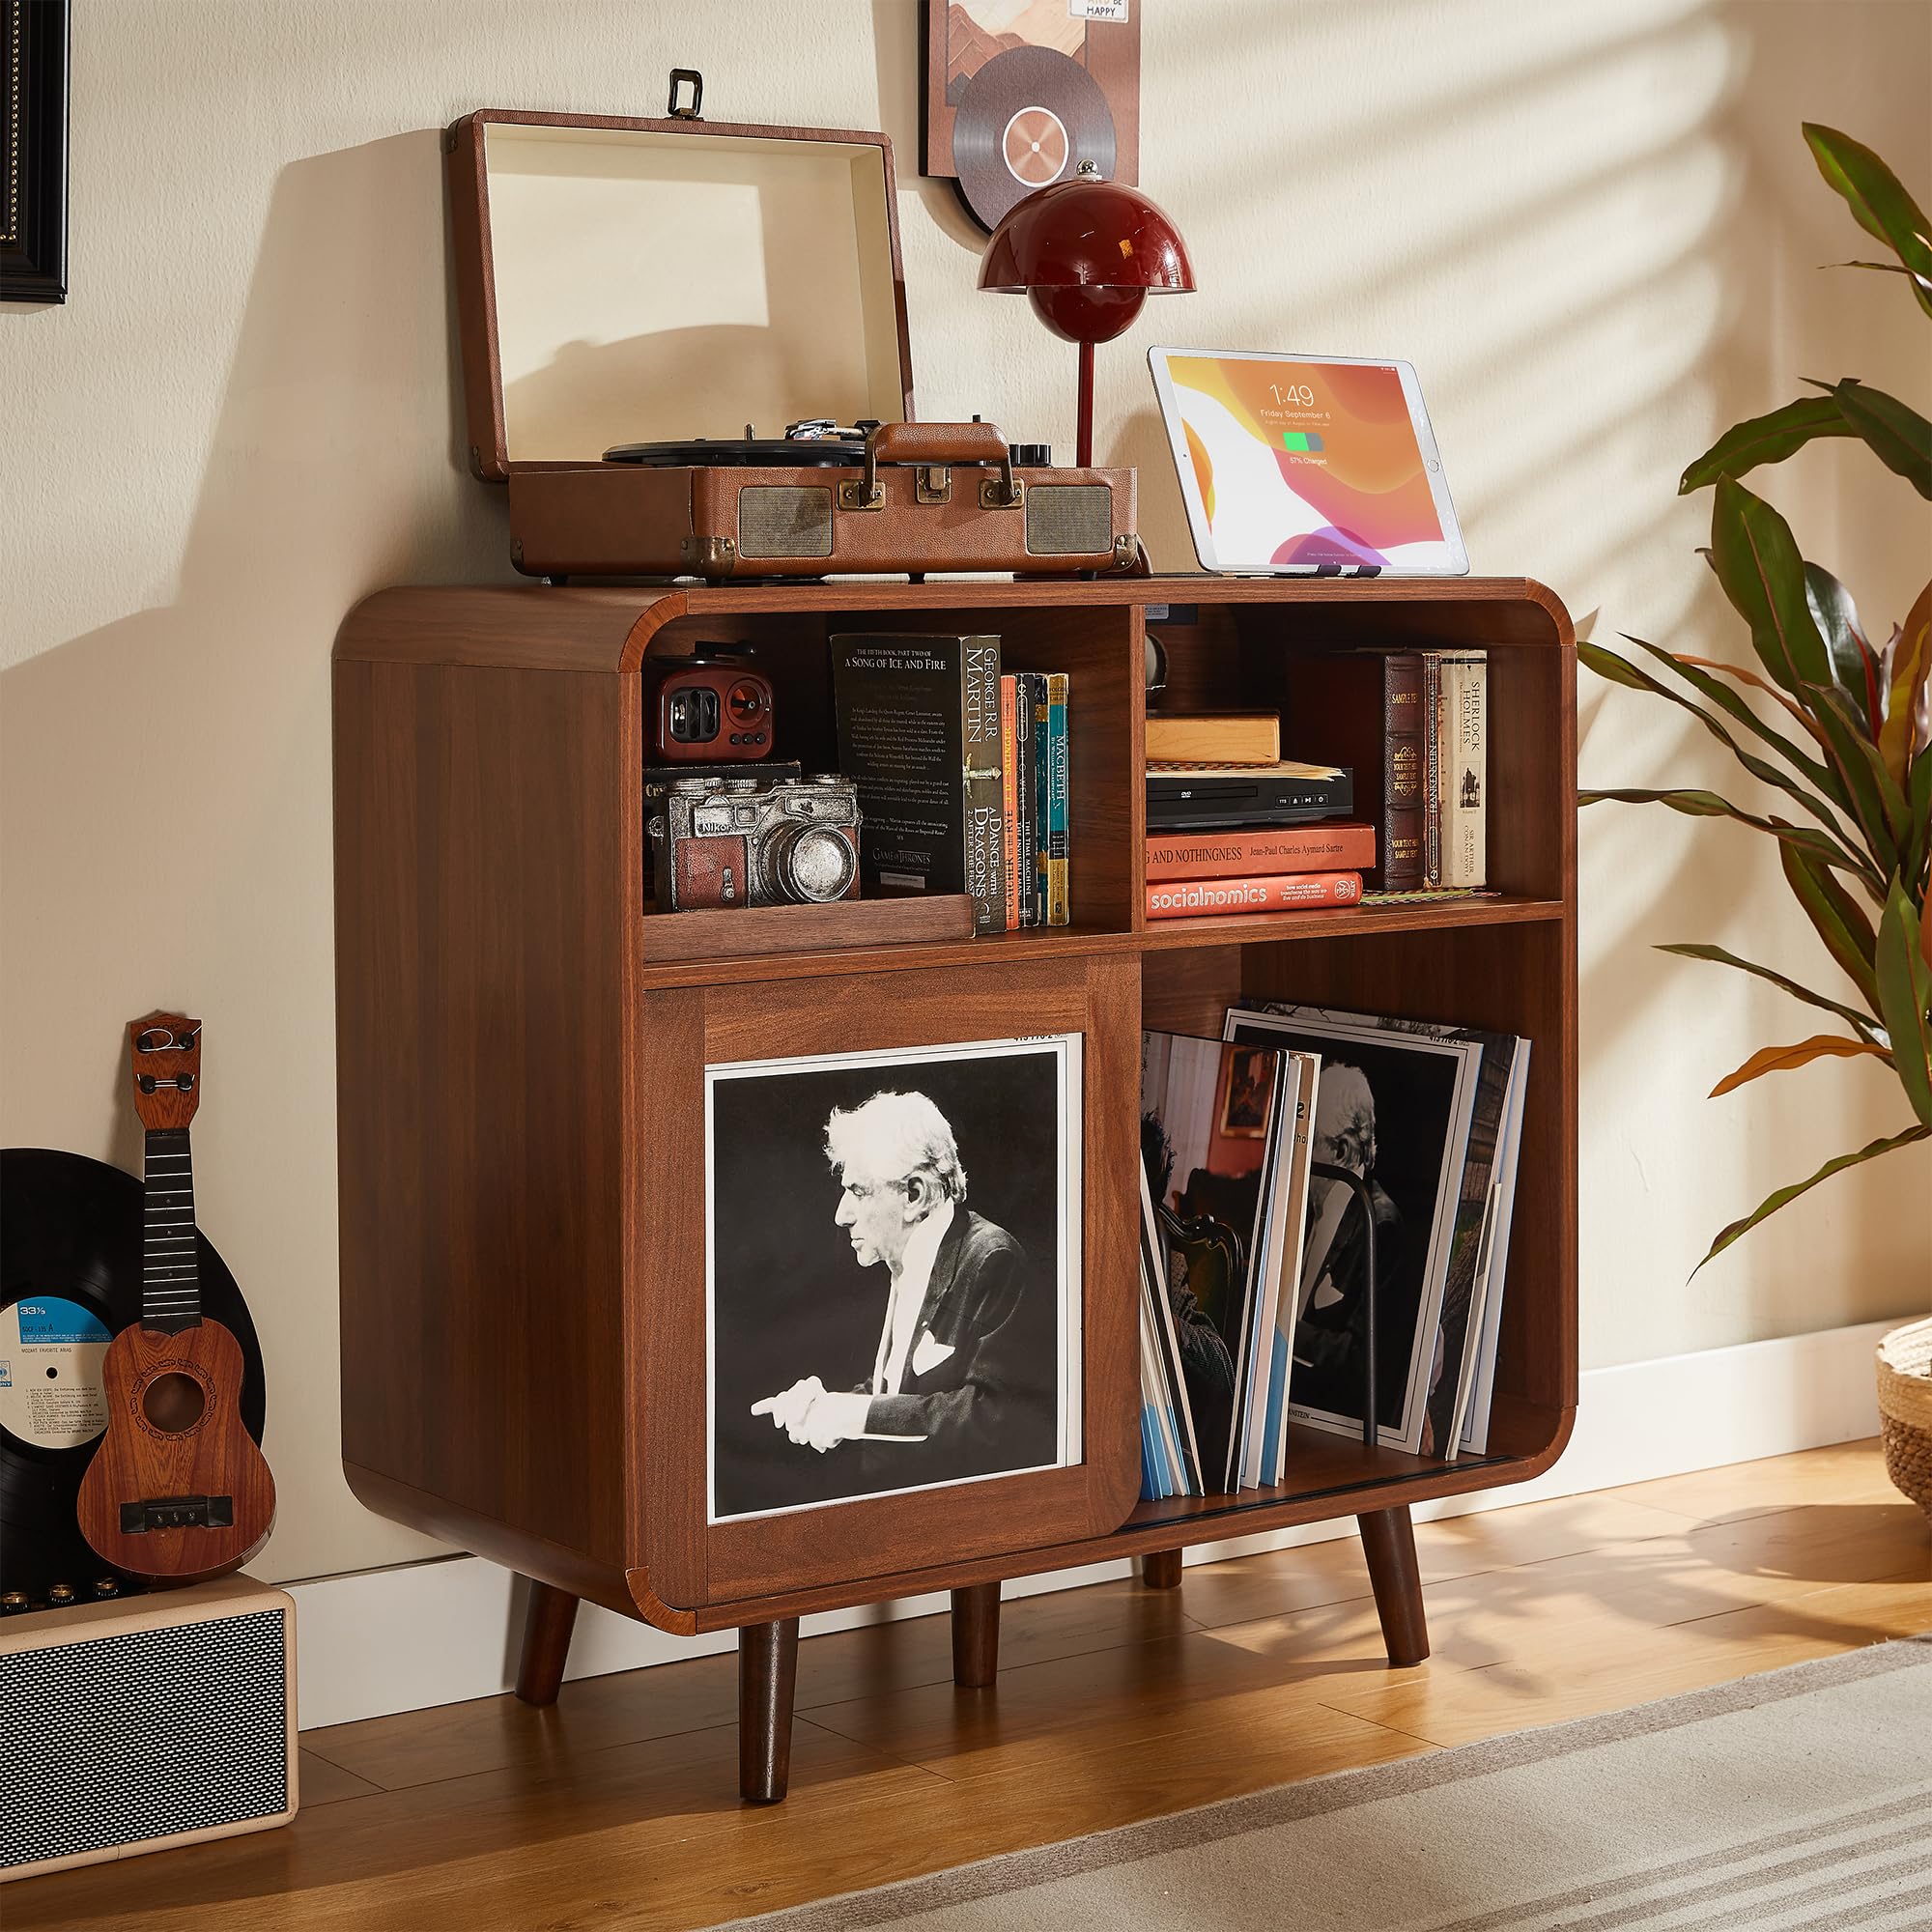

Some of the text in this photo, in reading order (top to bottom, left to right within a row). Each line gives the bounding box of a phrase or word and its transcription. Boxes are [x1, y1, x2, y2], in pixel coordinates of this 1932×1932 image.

[1086, 6, 1116, 16] HAPPY
[1260, 409, 1283, 419] Friday
[1285, 410, 1323, 419] September
[1269, 384, 1315, 407] 1:49
[844, 657, 947, 670] A SONG OF ICE AND FIRE
[983, 647, 998, 709] GEORGE
[966, 646, 983, 743] MARTIN
[1463, 690, 1471, 745] HOLMES
[1471, 681, 1480, 752] SHERLOCK
[1056, 735, 1065, 800] MACBETH
[1429, 744, 1438, 813] FRANKENSTEIN
[989, 817, 1002, 868] DANCE
[1005, 810, 1013, 834] RYE
[974, 807, 989, 898] DRAGONS
[1151, 850, 1174, 864] AND
[1175, 846, 1242, 863] NOTHINGNESS
[1249, 846, 1277, 857] Jean-Paul
[1278, 844, 1301, 855] Charles
[989, 871, 998, 895] WITH
[1006, 857, 1014, 908] CATCHER
[1151, 883, 1267, 910] socialnomics
